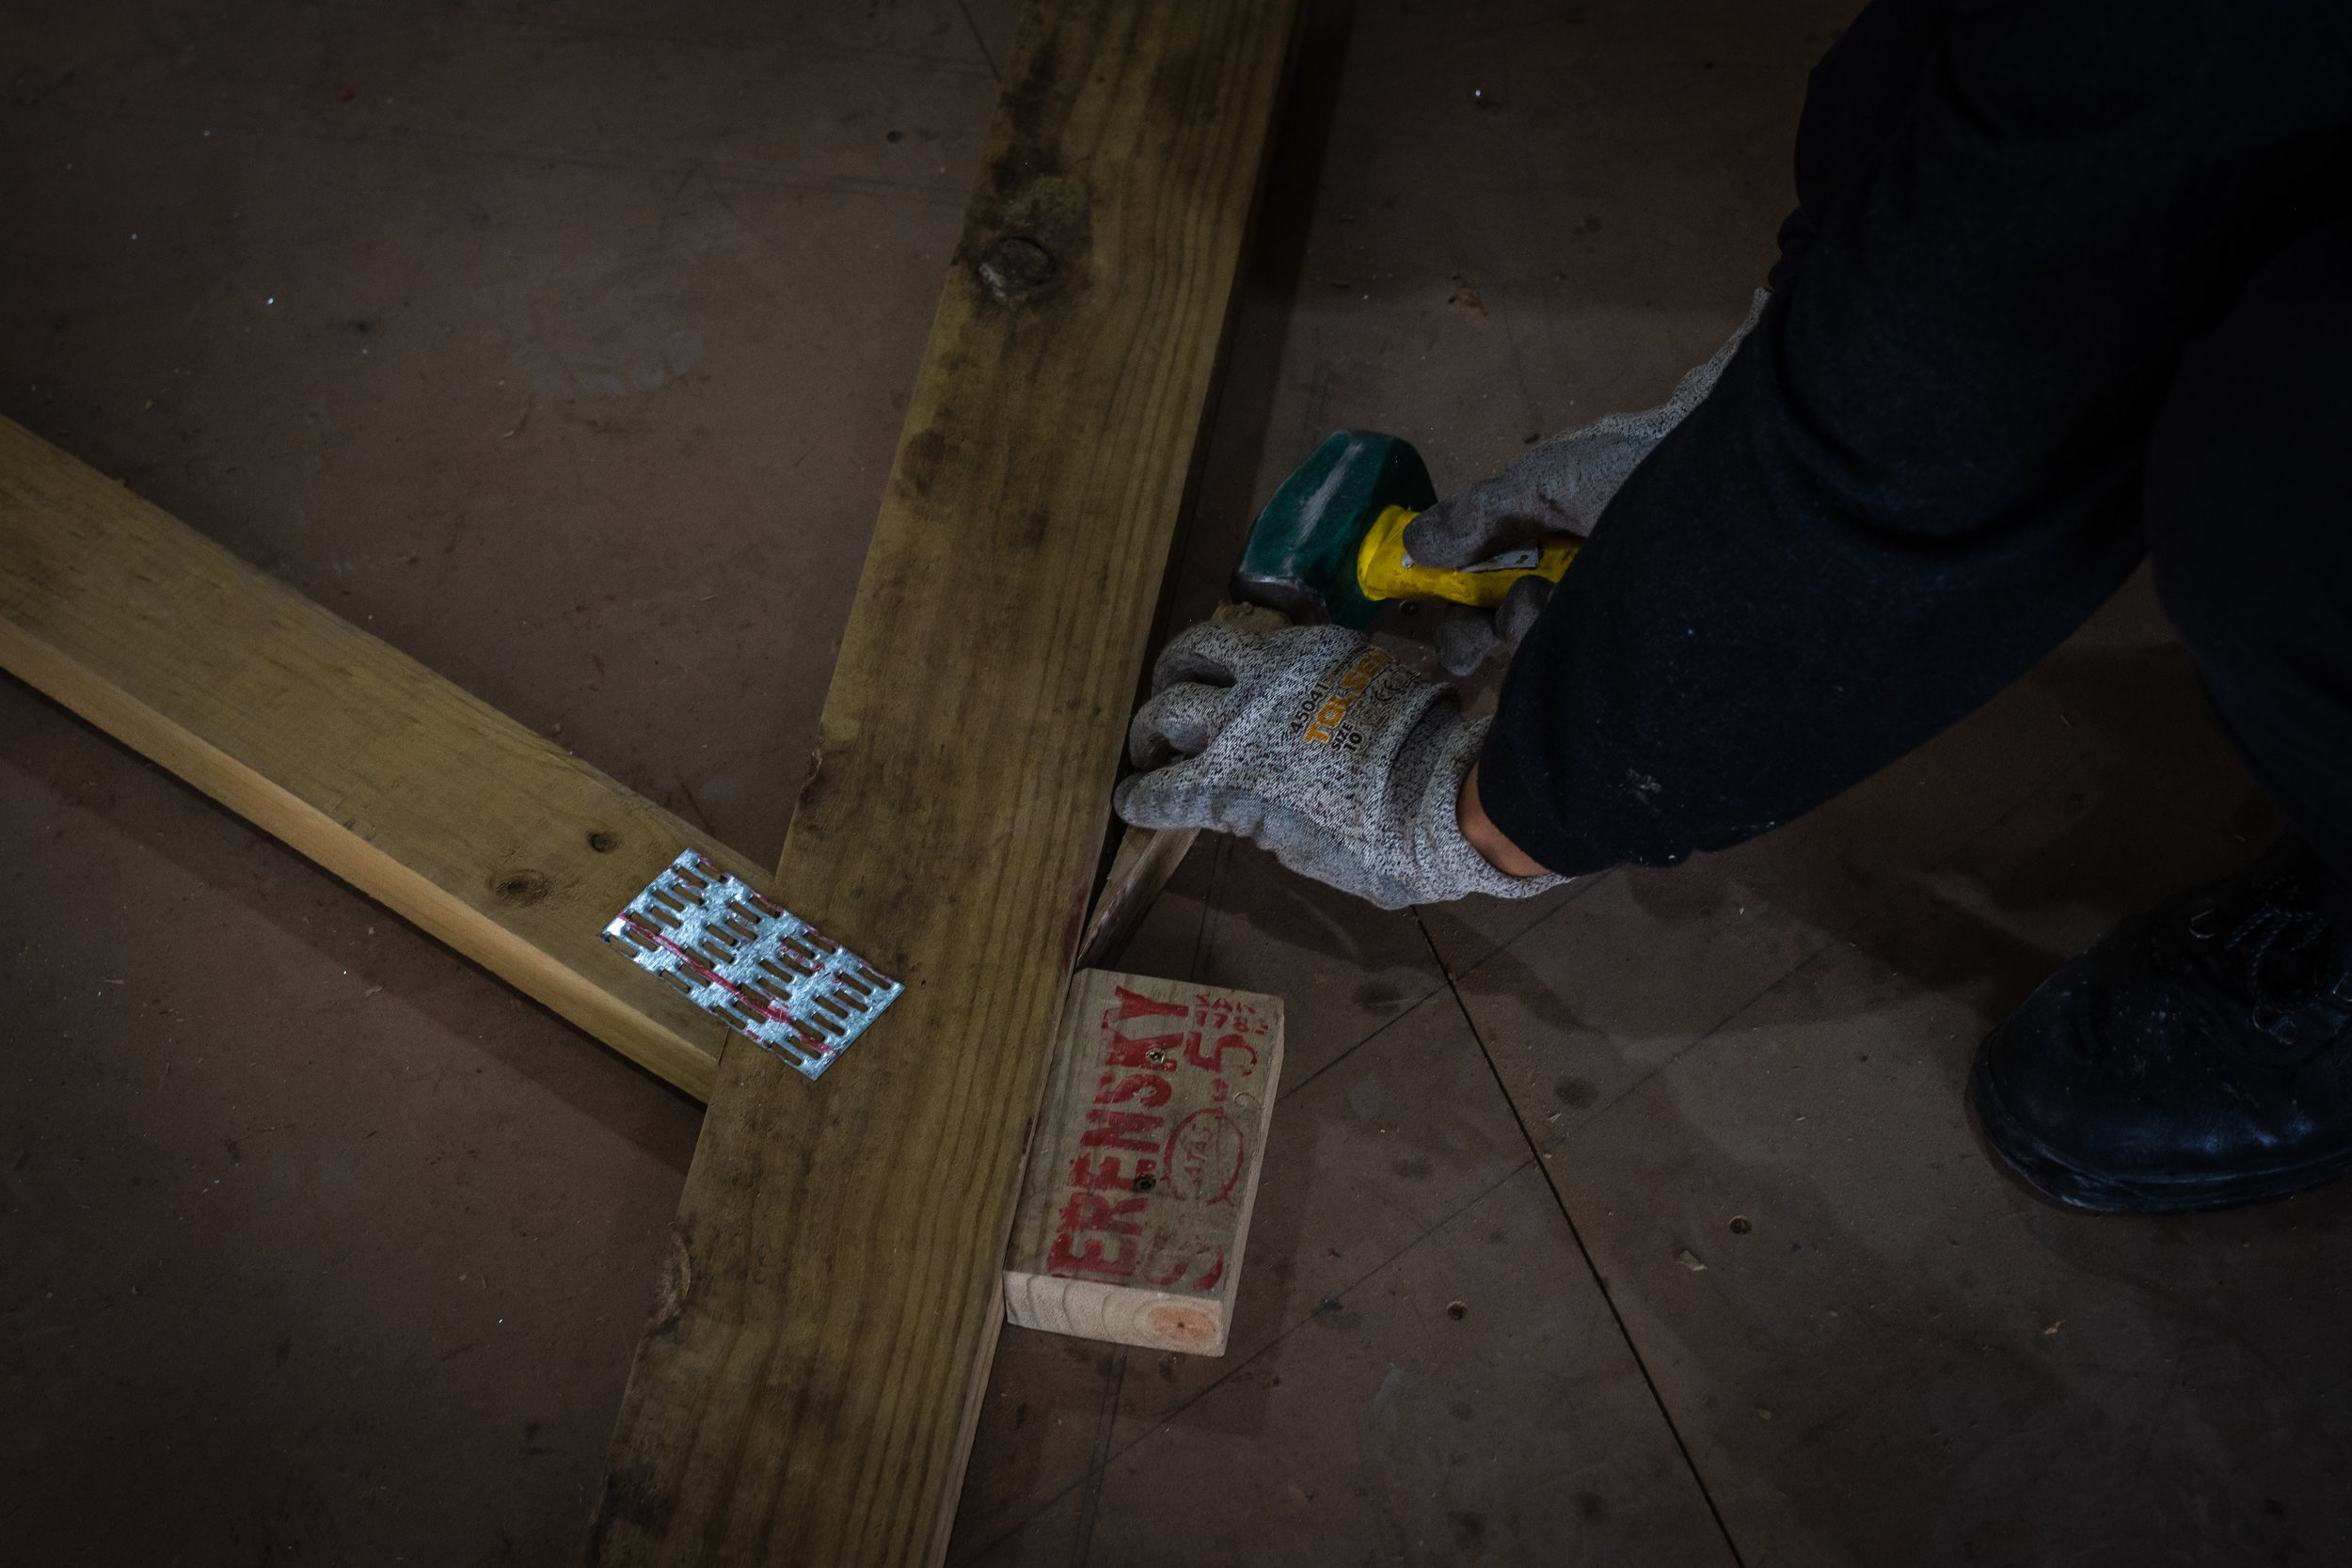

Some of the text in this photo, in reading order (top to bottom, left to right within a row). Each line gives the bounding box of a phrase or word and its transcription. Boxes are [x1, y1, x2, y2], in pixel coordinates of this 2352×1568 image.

[1290, 683, 1328, 734] 45041
[1331, 722, 1354, 751] SIZE
[1343, 733, 1362, 752] 10
[1046, 986, 1189, 1285] ERENSKY
